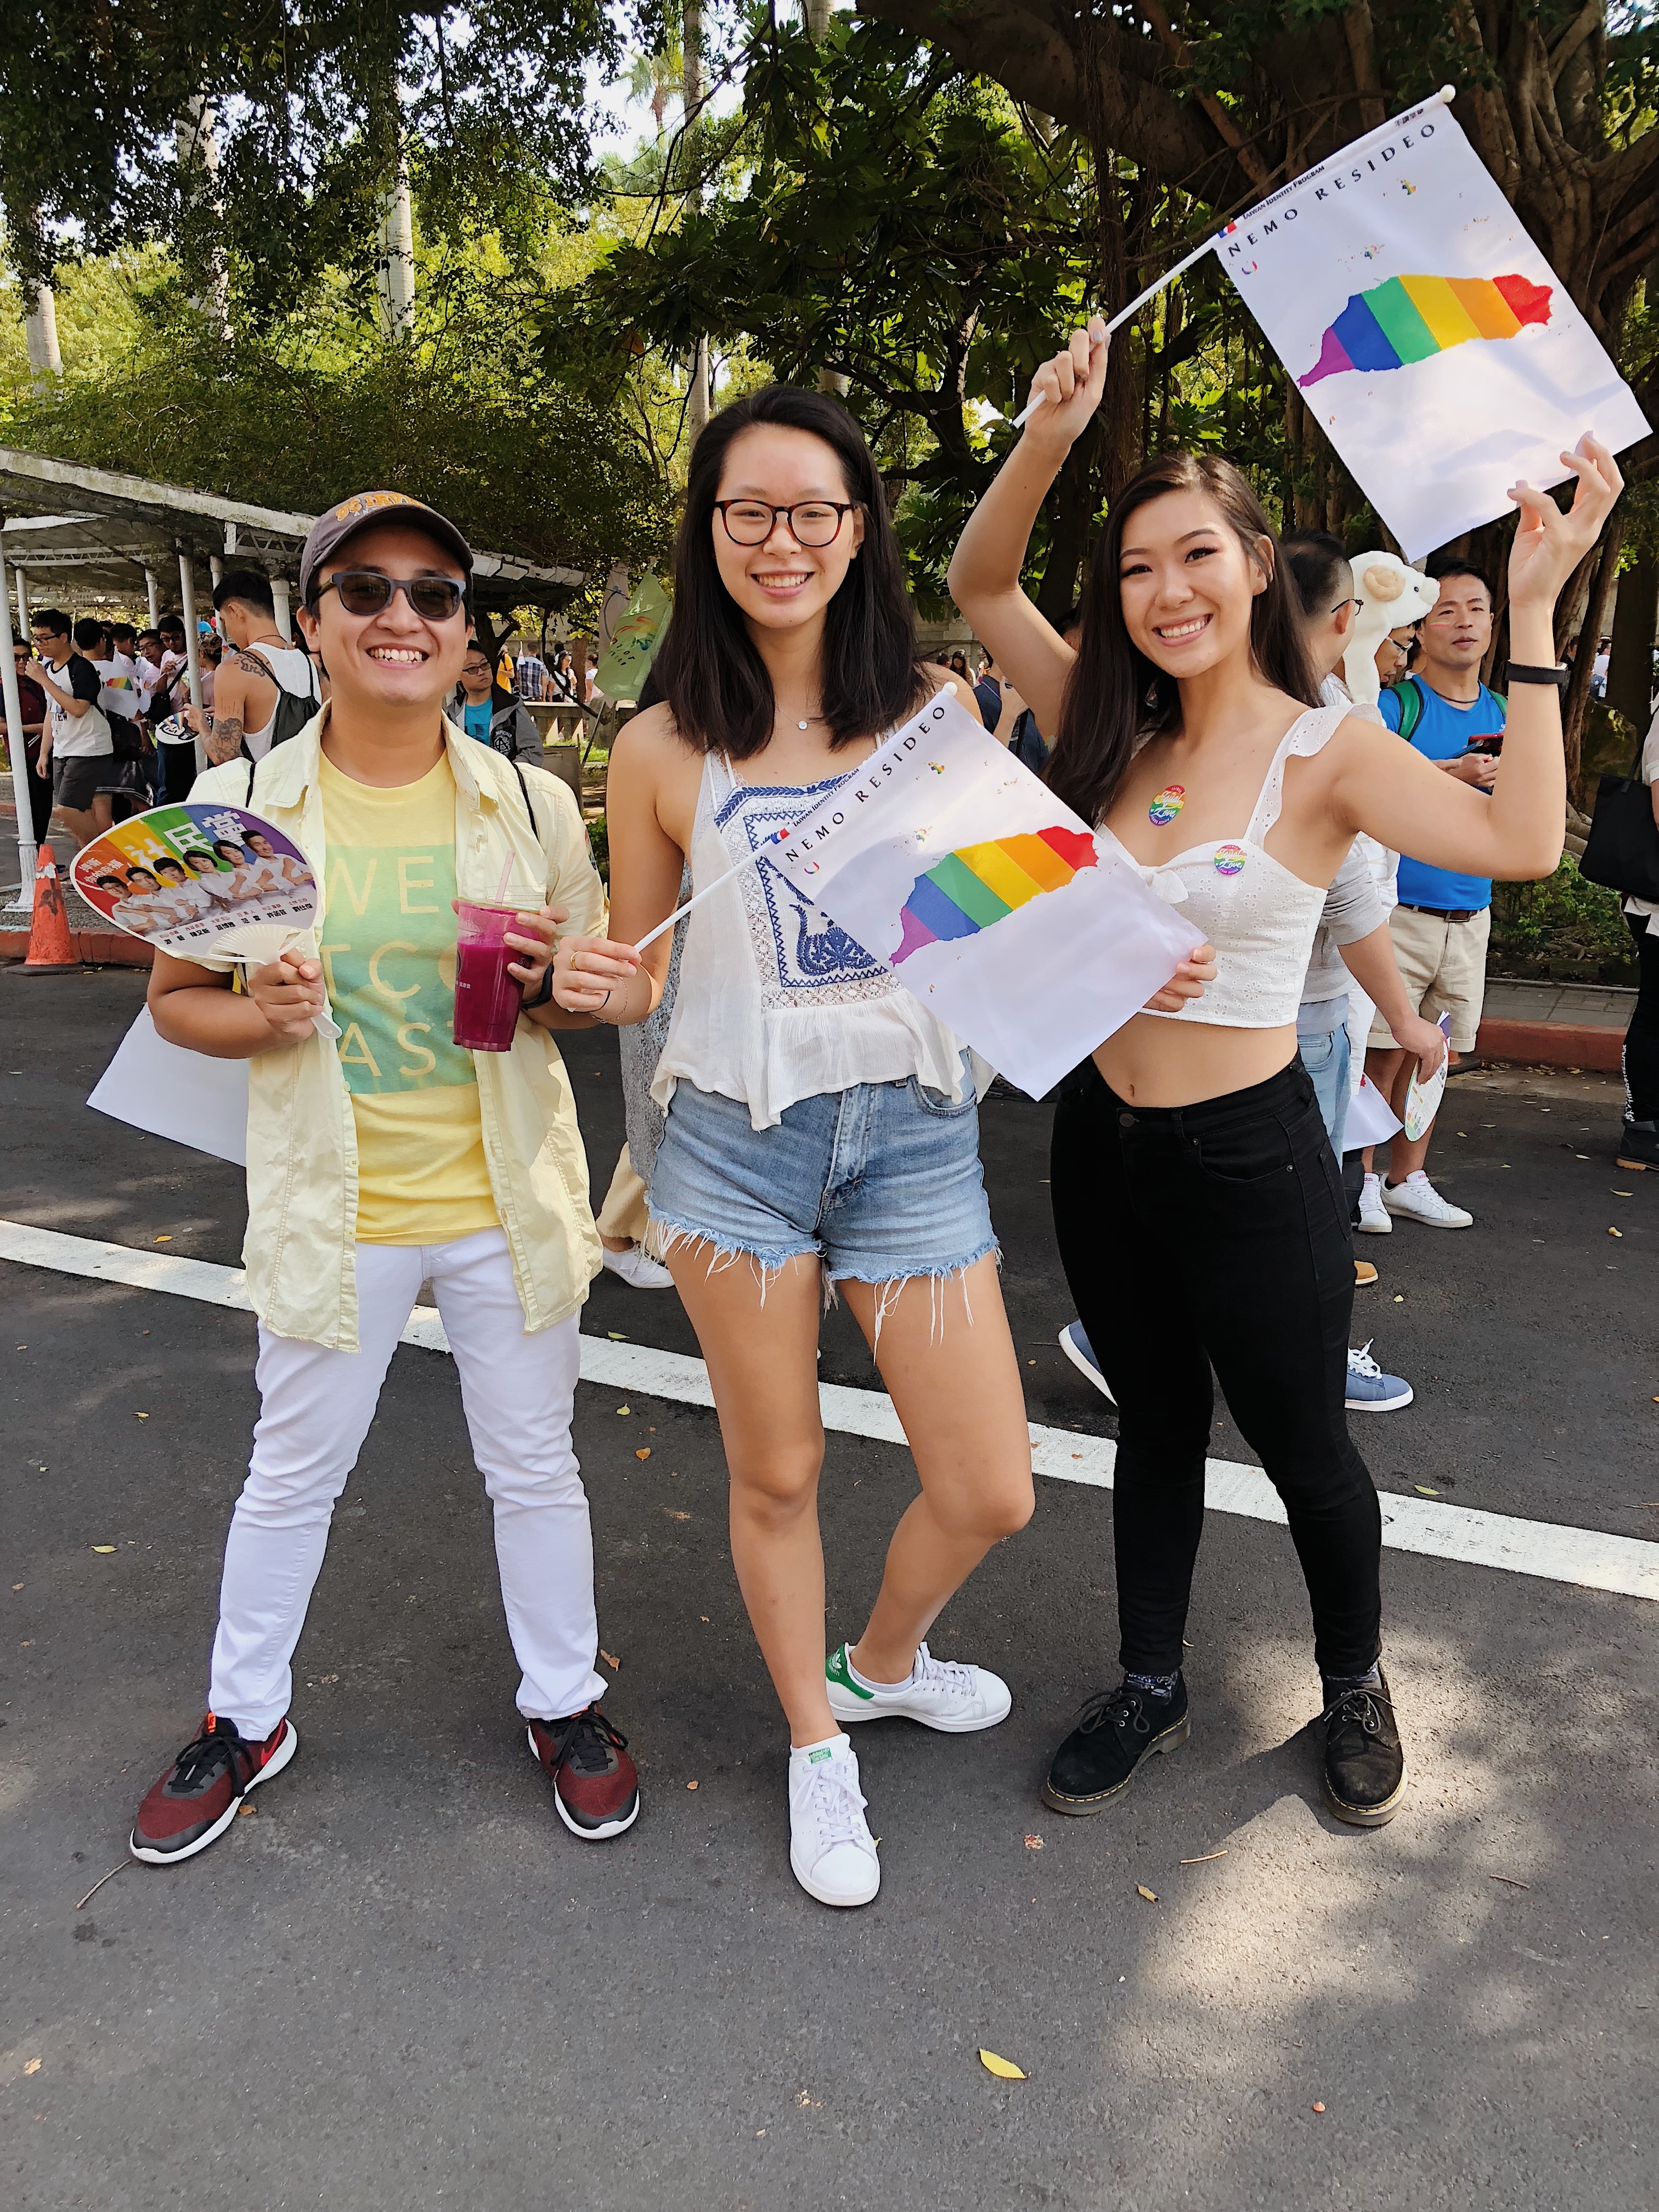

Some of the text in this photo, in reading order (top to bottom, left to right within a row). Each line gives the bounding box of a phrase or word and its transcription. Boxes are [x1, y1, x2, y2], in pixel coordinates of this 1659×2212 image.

[1228, 124, 1435, 257] NEMO RESIDEO
[1266, 184, 1293, 205] IDENTITY
[1293, 165, 1325, 188] PROGRAM
[336, 498, 363, 522] UC
[785, 707, 945, 862] NEMO RESIDEO
[792, 768, 860, 827] TAIWAN IDENTITY PROGRAM
[1155, 791, 1186, 808] Equal
[1151, 808, 1176, 819] Love
[123, 811, 247, 873] 社民黨
[1216, 849, 1243, 861] Equal
[1218, 861, 1243, 869] Love
[325, 856, 439, 915] WE
